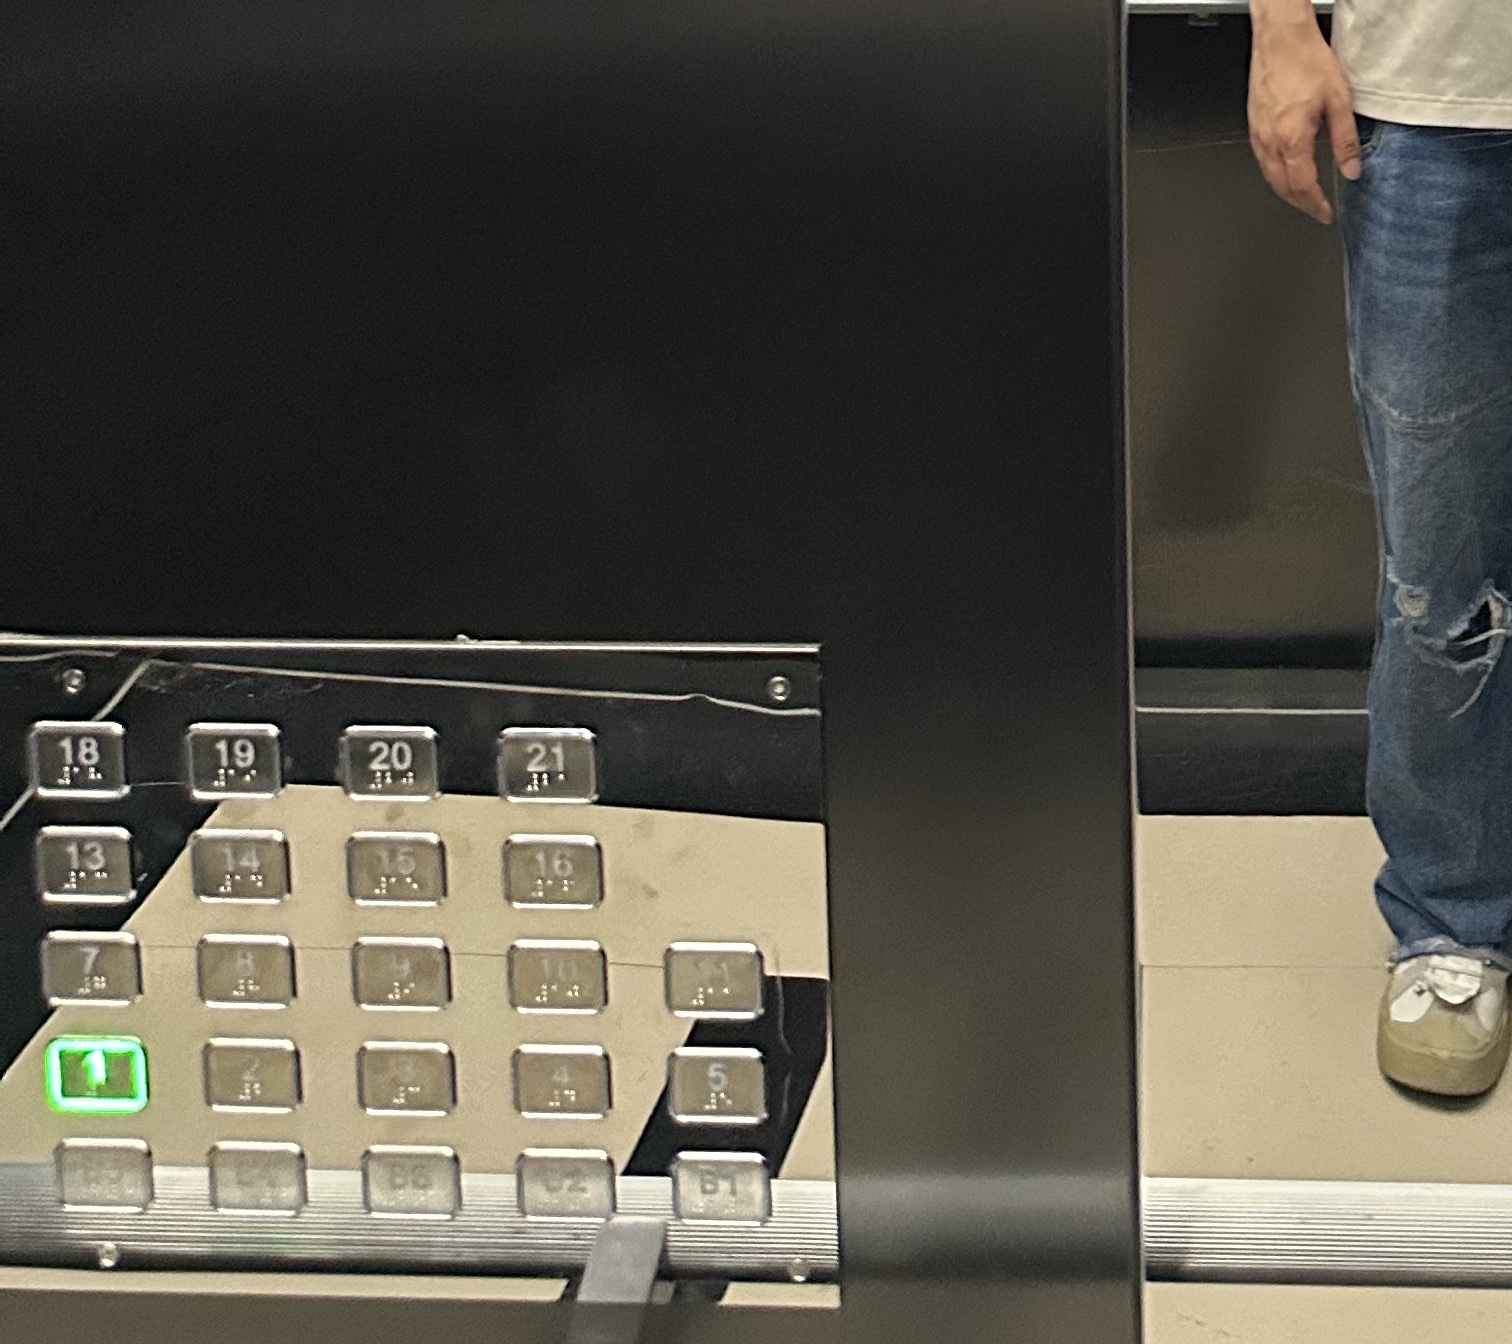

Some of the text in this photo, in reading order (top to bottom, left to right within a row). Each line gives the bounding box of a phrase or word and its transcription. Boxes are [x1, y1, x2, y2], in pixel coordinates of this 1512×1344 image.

[58, 737, 101, 766] 18
[214, 738, 256, 769] 19
[368, 741, 413, 772] 20
[526, 743, 565, 772] 21
[64, 841, 106, 871] 13
[222, 844, 261, 872] 14
[378, 846, 416, 875] 15
[535, 849, 573, 878] 16
[79, 946, 101, 975] 7
[82, 1049, 107, 1085] 1
[708, 1062, 728, 1092] 5
[699, 1166, 738, 1197] B1
